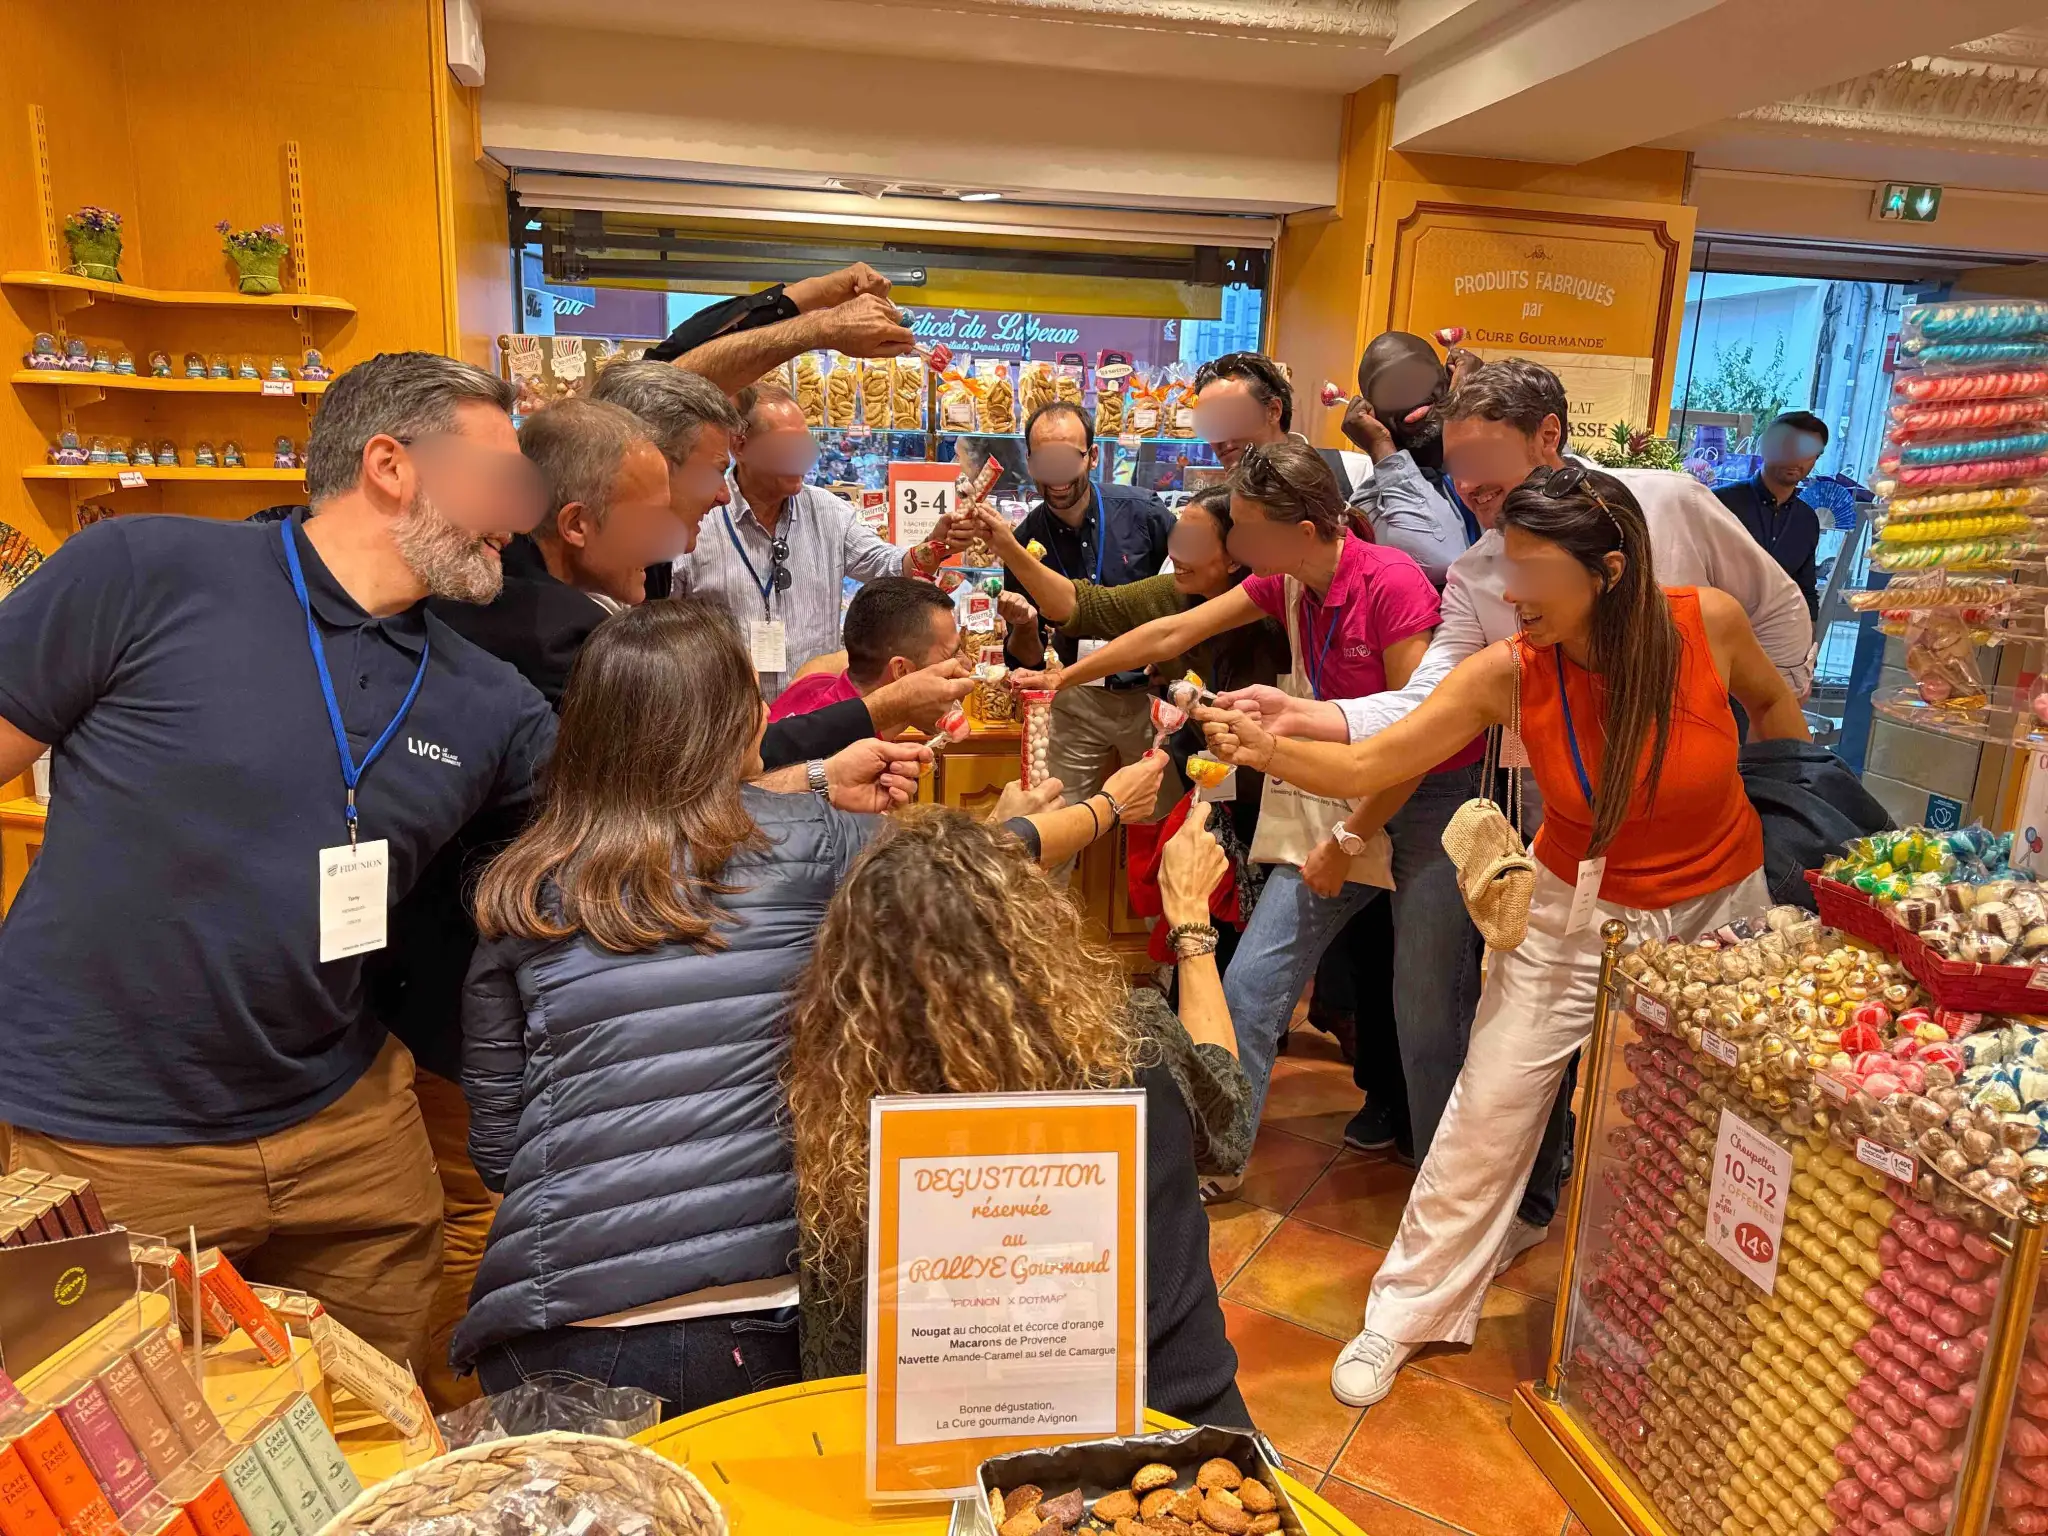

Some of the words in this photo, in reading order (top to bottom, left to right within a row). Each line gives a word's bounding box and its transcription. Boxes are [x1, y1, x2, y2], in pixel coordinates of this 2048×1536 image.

[1454, 270, 1529, 296] PRODUITS
[1536, 272, 1616, 307] FABRIQUÉS
[1522, 301, 1544, 320] par
[911, 311, 957, 338] élices
[958, 314, 987, 340] du
[992, 312, 1080, 345] Luberon
[970, 341, 1001, 353] Depuis
[1001, 343, 1020, 353] 1970
[1568, 401, 1595, 415] LAT
[903, 488, 948, 515] 3=4
[408, 736, 441, 760] LVC
[1730, 1133, 1778, 1176] Choupettes
[1861, 1147, 1888, 1163] CHOCOLAT
[914, 1163, 1106, 1199] DEGUSTATION
[971, 1195, 1052, 1219] réservée
[1728, 1184, 1776, 1224] OFFERTES
[1001, 1233, 1028, 1247] au
[908, 1254, 1008, 1284] RALLYE
[1010, 1248, 1111, 1285] Gourmand
[911, 1326, 951, 1339] Nougat
[953, 1326, 966, 1336] au
[968, 1323, 1011, 1335] chocolat
[1013, 1322, 1023, 1332] et
[1025, 1321, 1059, 1332] écorce
[1061, 1320, 1105, 1331] d'orange
[949, 1338, 1002, 1349] Macarons
[1004, 1336, 1018, 1347] de
[1020, 1335, 1067, 1346] Provence
[898, 1354, 940, 1365] Navette
[942, 1350, 1023, 1363] Amande-Caramel
[1025, 1350, 1037, 1359] au
[1039, 1348, 1053, 1358] sel
[1055, 1347, 1067, 1357] de
[1068, 1346, 1116, 1357] Camargue
[959, 1404, 992, 1415] Bonne
[994, 1401, 1055, 1414] dégustation,
[936, 1419, 949, 1430] La
[952, 1417, 976, 1429] Cure
[978, 1414, 1036, 1429] gourmande
[1037, 1413, 1078, 1426] Avignon
